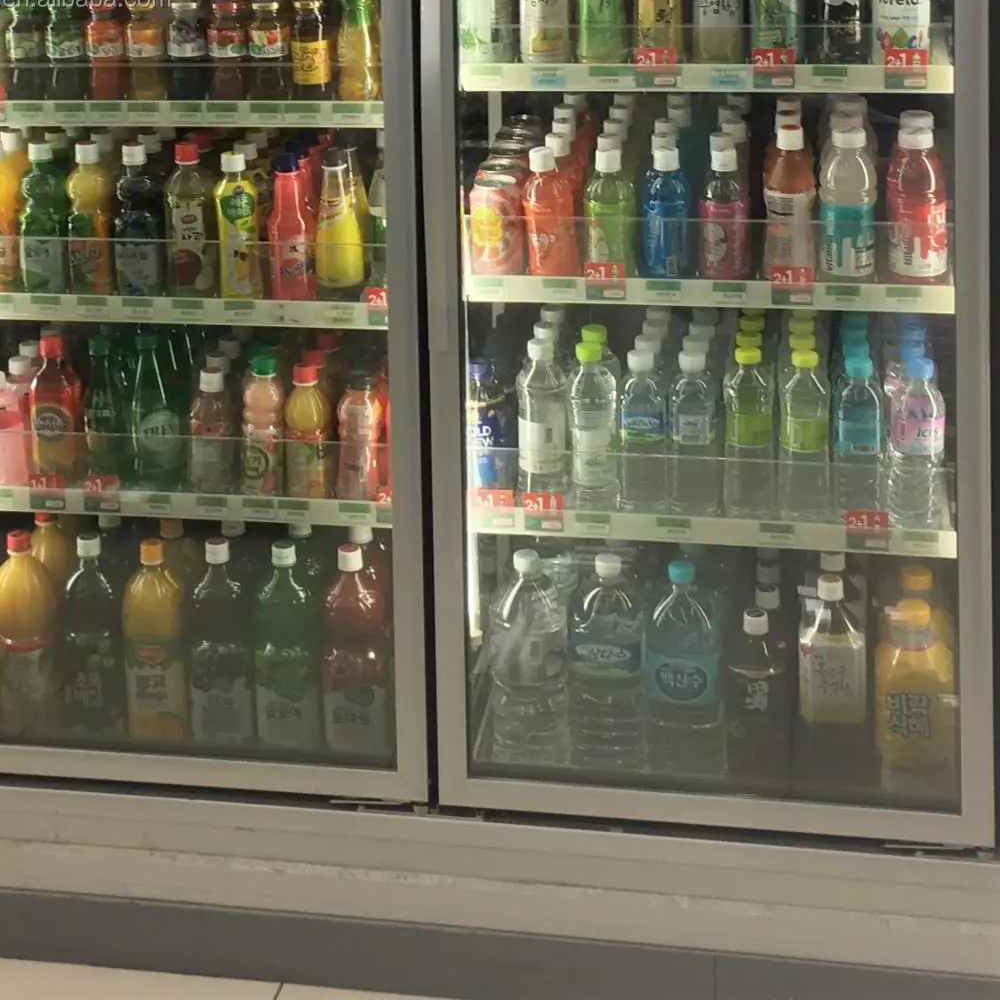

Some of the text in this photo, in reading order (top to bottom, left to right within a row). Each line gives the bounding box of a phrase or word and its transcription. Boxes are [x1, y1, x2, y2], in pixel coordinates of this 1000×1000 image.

[754, 52, 775, 68] 2+1
[886, 53, 907, 68] 2+1
[773, 269, 793, 285] 2+1
[525, 497, 544, 511] 2+1
[848, 515, 868, 530] 2+1
